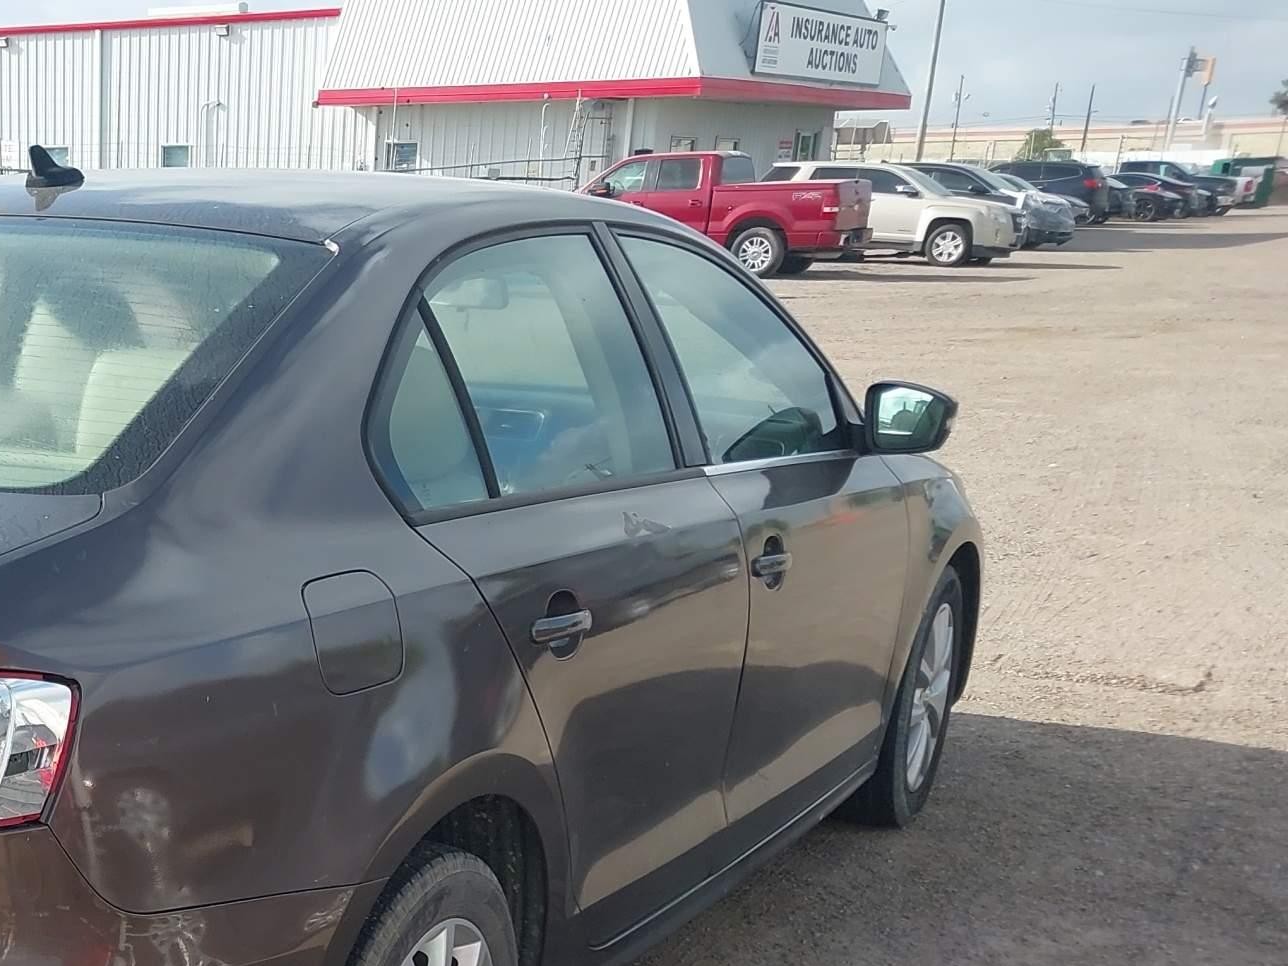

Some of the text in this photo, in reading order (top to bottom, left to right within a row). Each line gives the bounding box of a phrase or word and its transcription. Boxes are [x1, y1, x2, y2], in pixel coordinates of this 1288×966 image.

[790, 16, 879, 50] INSURANCE AUTO
[806, 47, 858, 74] AUCTIONS
